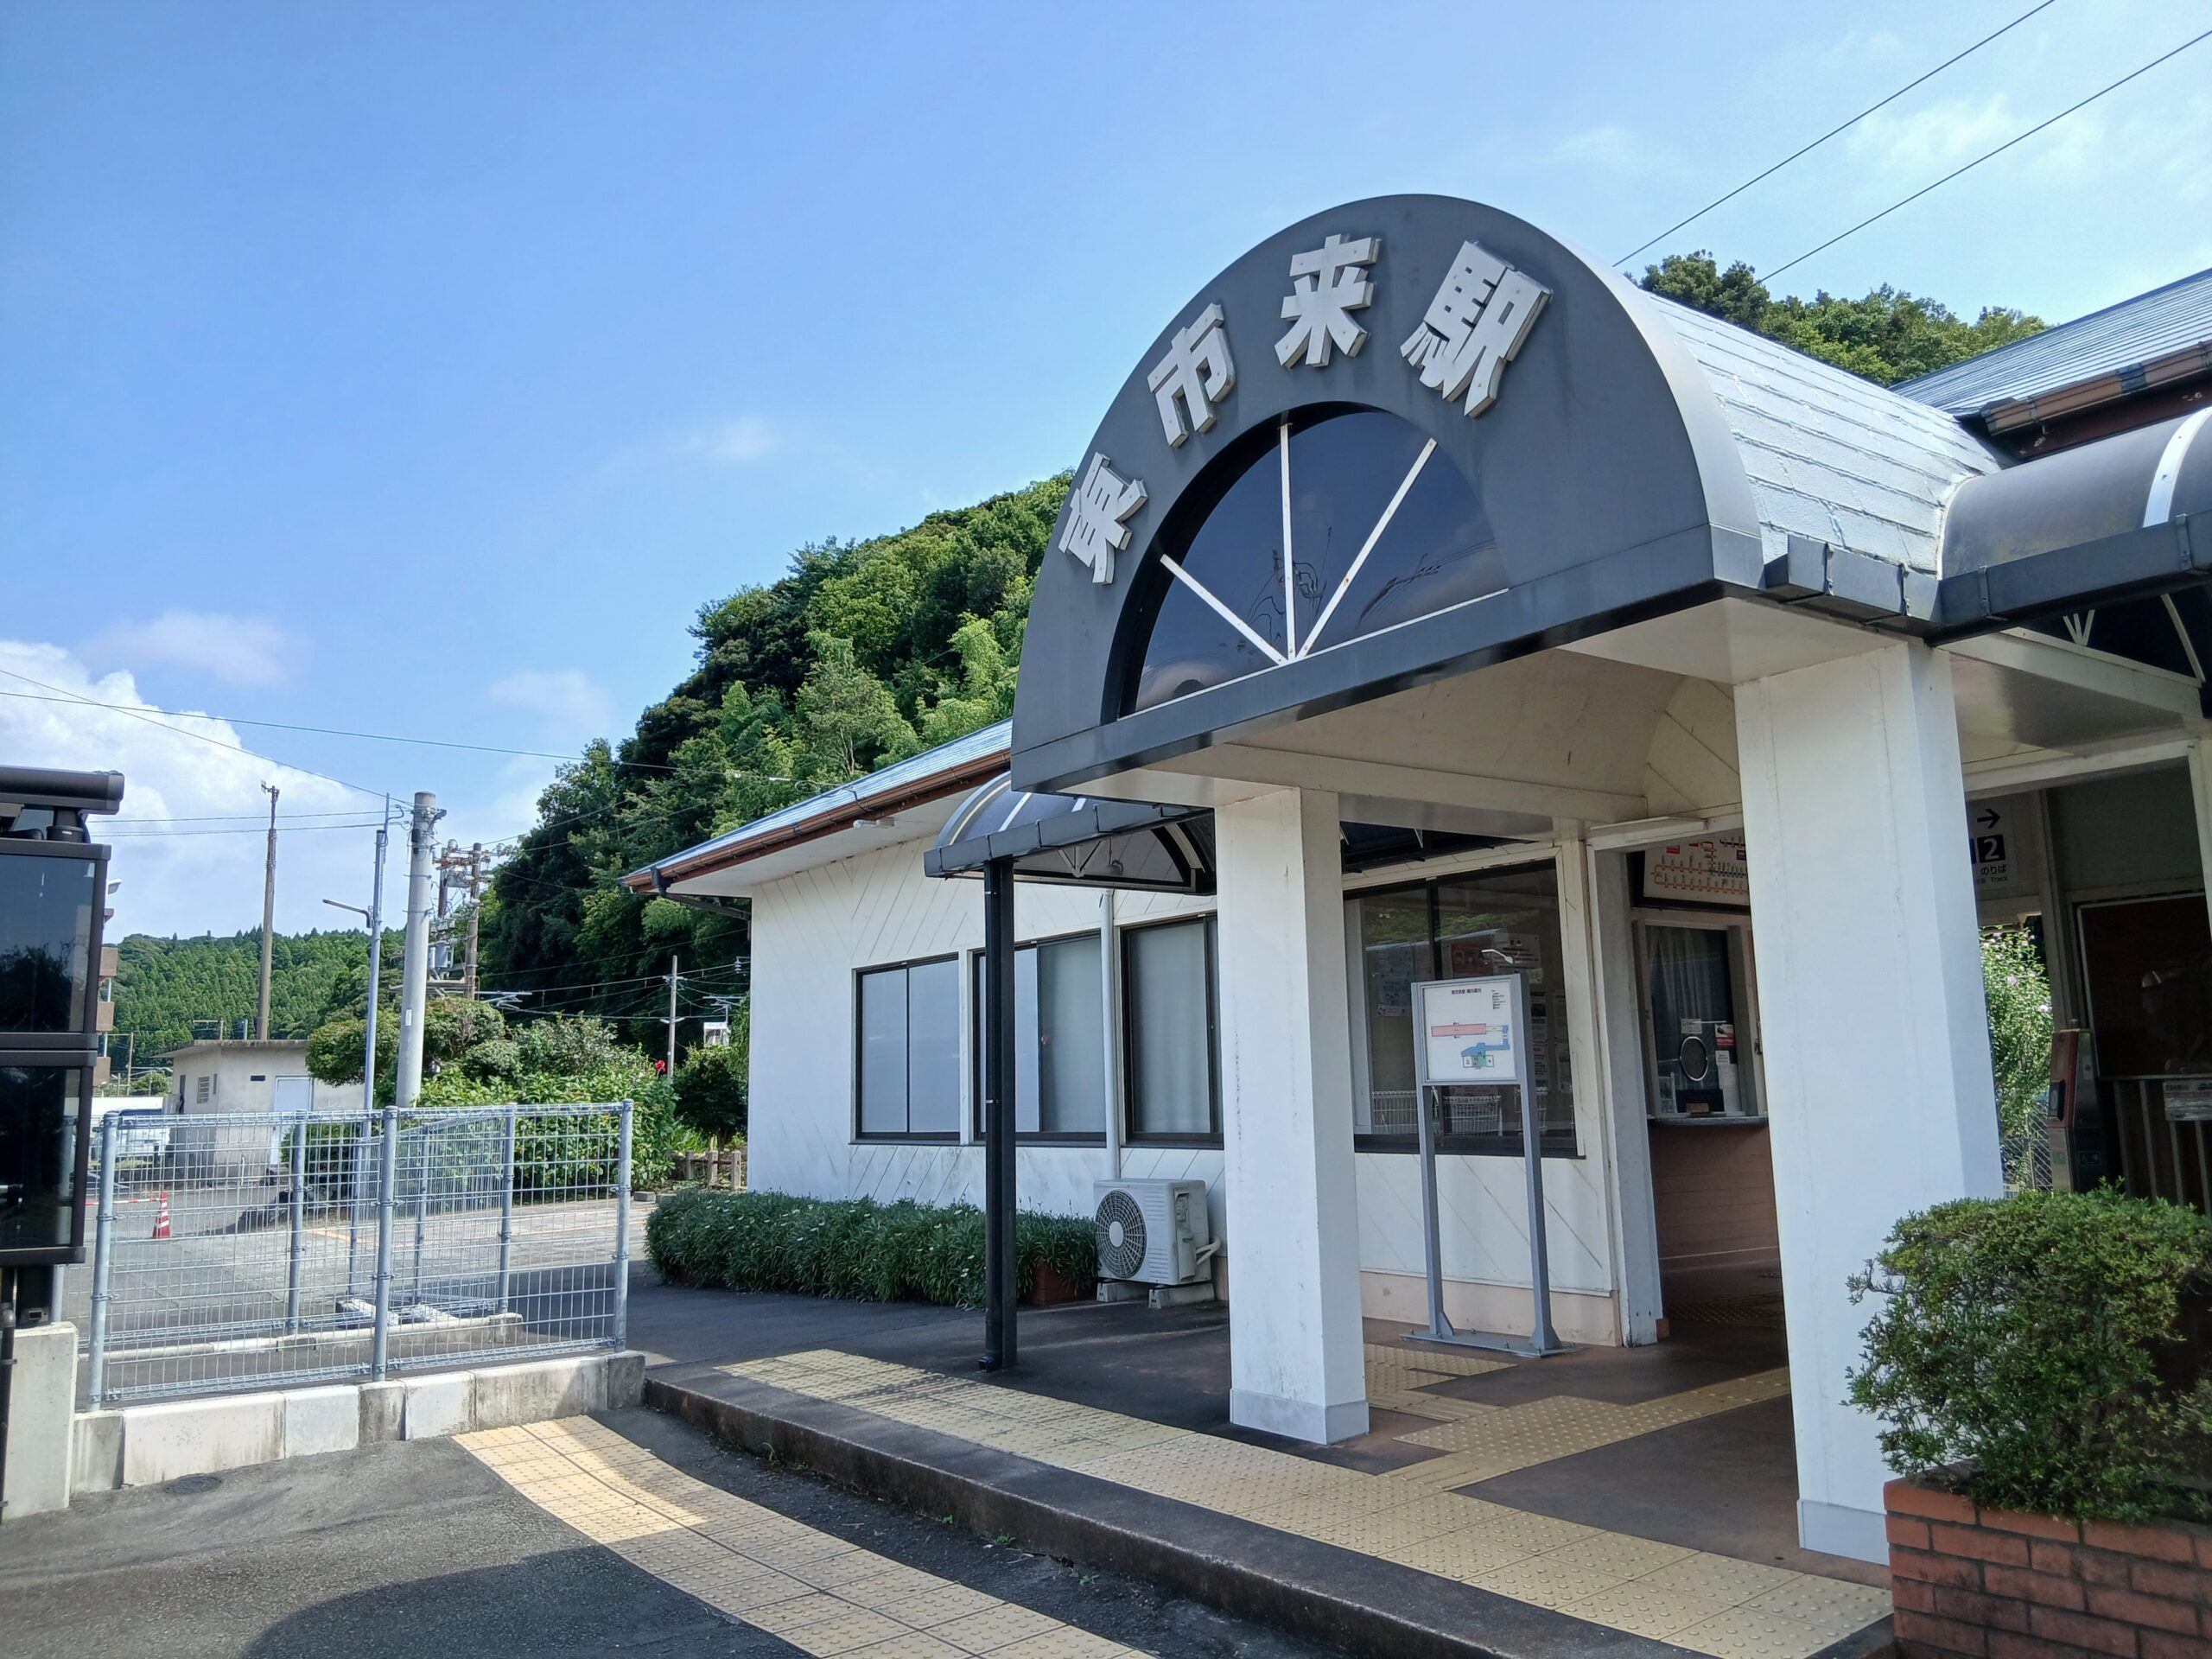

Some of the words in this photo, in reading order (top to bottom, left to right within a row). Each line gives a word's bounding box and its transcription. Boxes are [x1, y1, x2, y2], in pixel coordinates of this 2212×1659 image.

[1058, 233, 1552, 585] 東市来駅
[1983, 837, 1999, 861] 2
[1980, 864, 2007, 875] のりば
